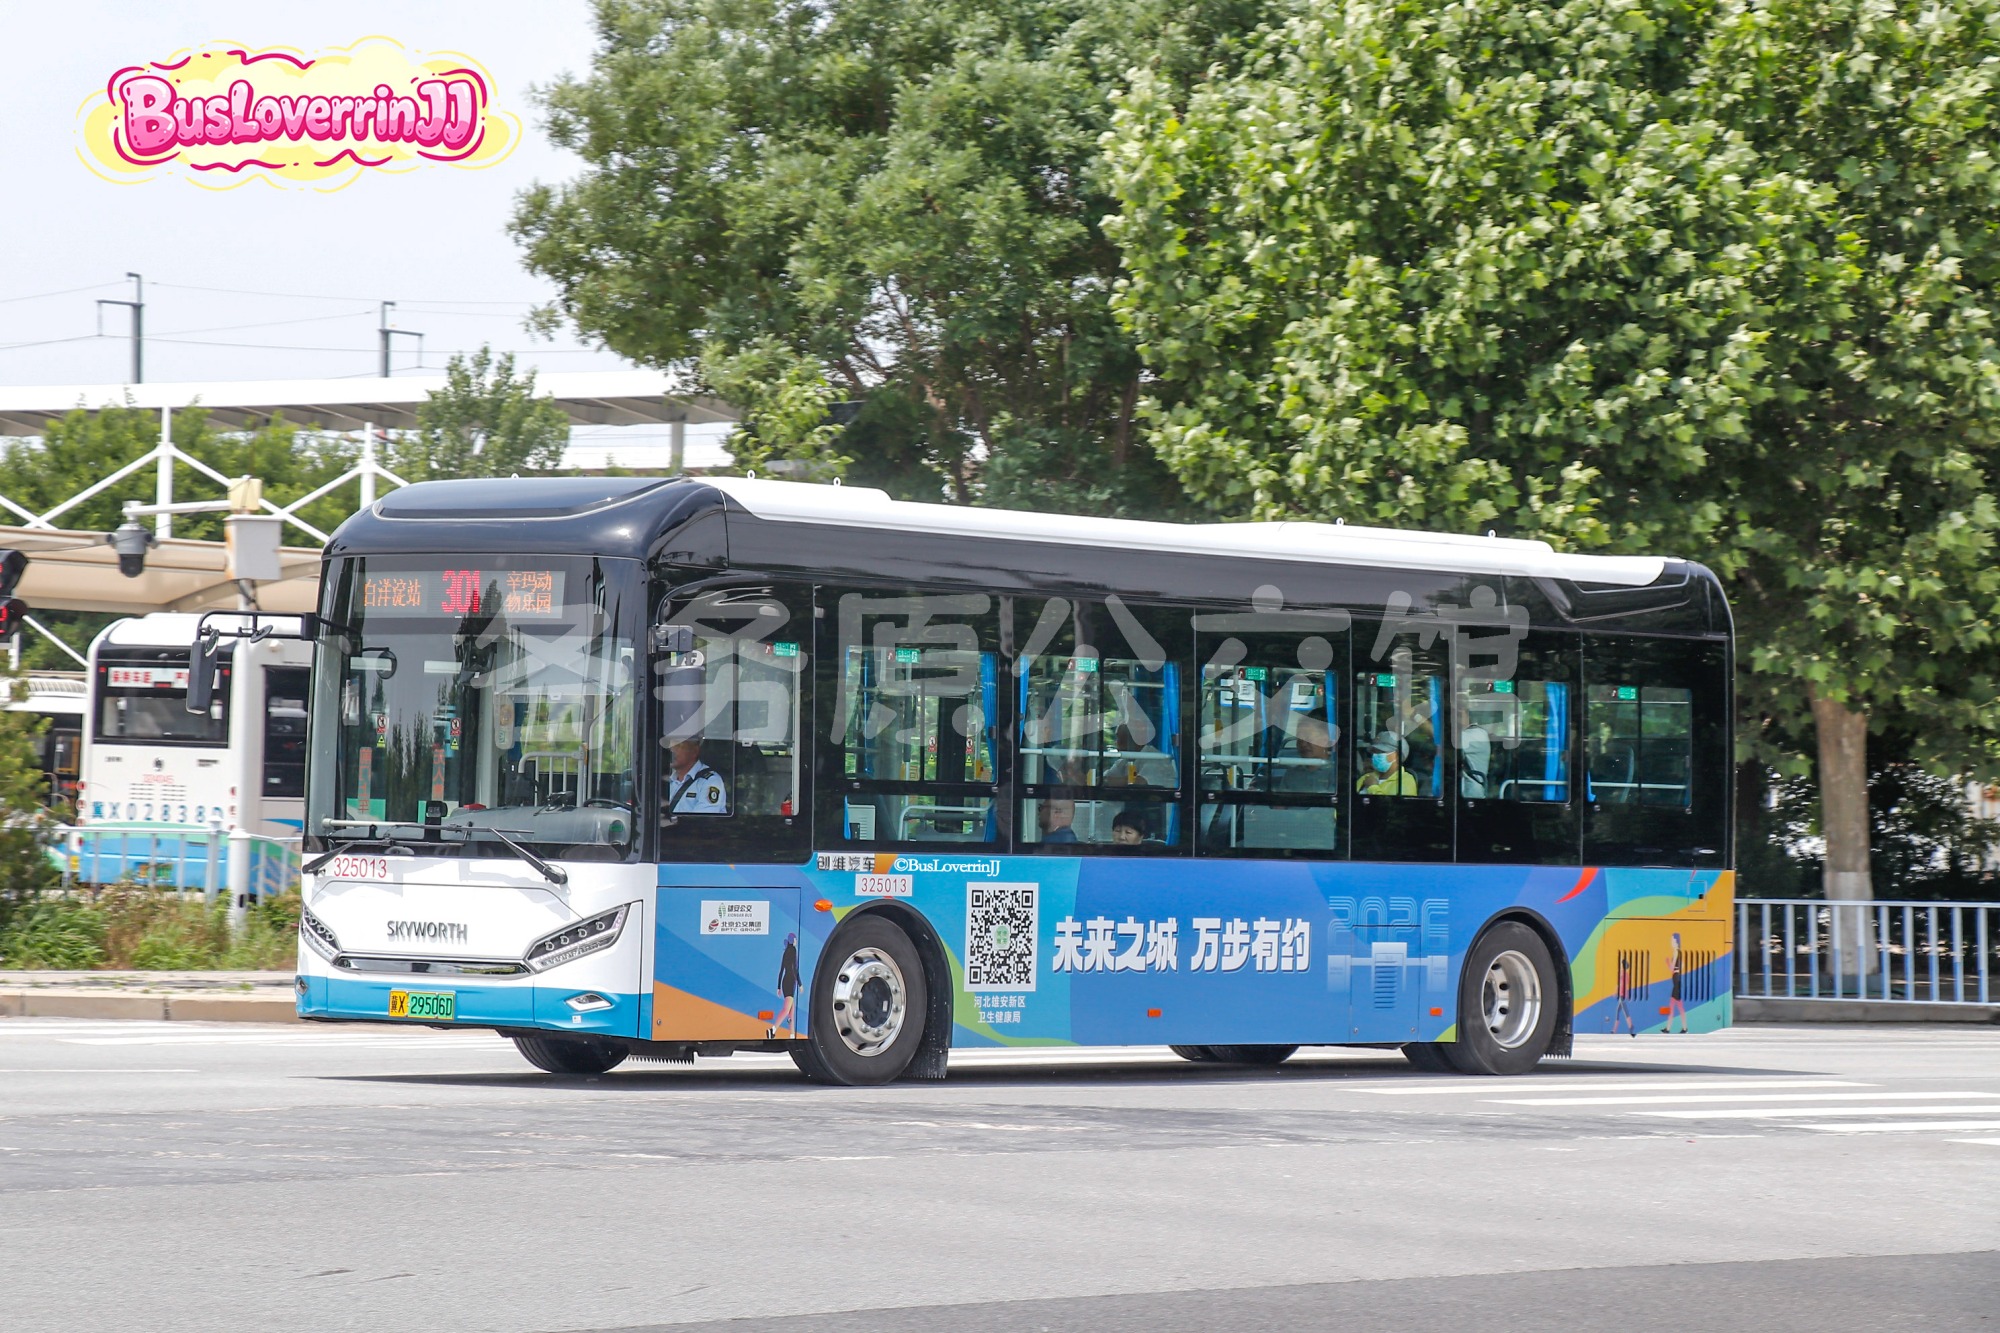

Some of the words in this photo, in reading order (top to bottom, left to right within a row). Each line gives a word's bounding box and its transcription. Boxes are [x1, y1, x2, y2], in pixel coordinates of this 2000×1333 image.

[364, 578, 421, 607] 白洋淀站
[441, 570, 480, 613] 301
[506, 593, 552, 613] 物乐园
[333, 858, 387, 879] 325013
[861, 877, 907, 893] 325013
[387, 921, 467, 943] SKYWORTH
[1053, 915, 1179, 973] 未来之城
[1191, 917, 1311, 973] 万步有约
[974, 995, 1026, 1008] 河北雄安新区
[977, 1011, 1021, 1023] 卫生健康局
